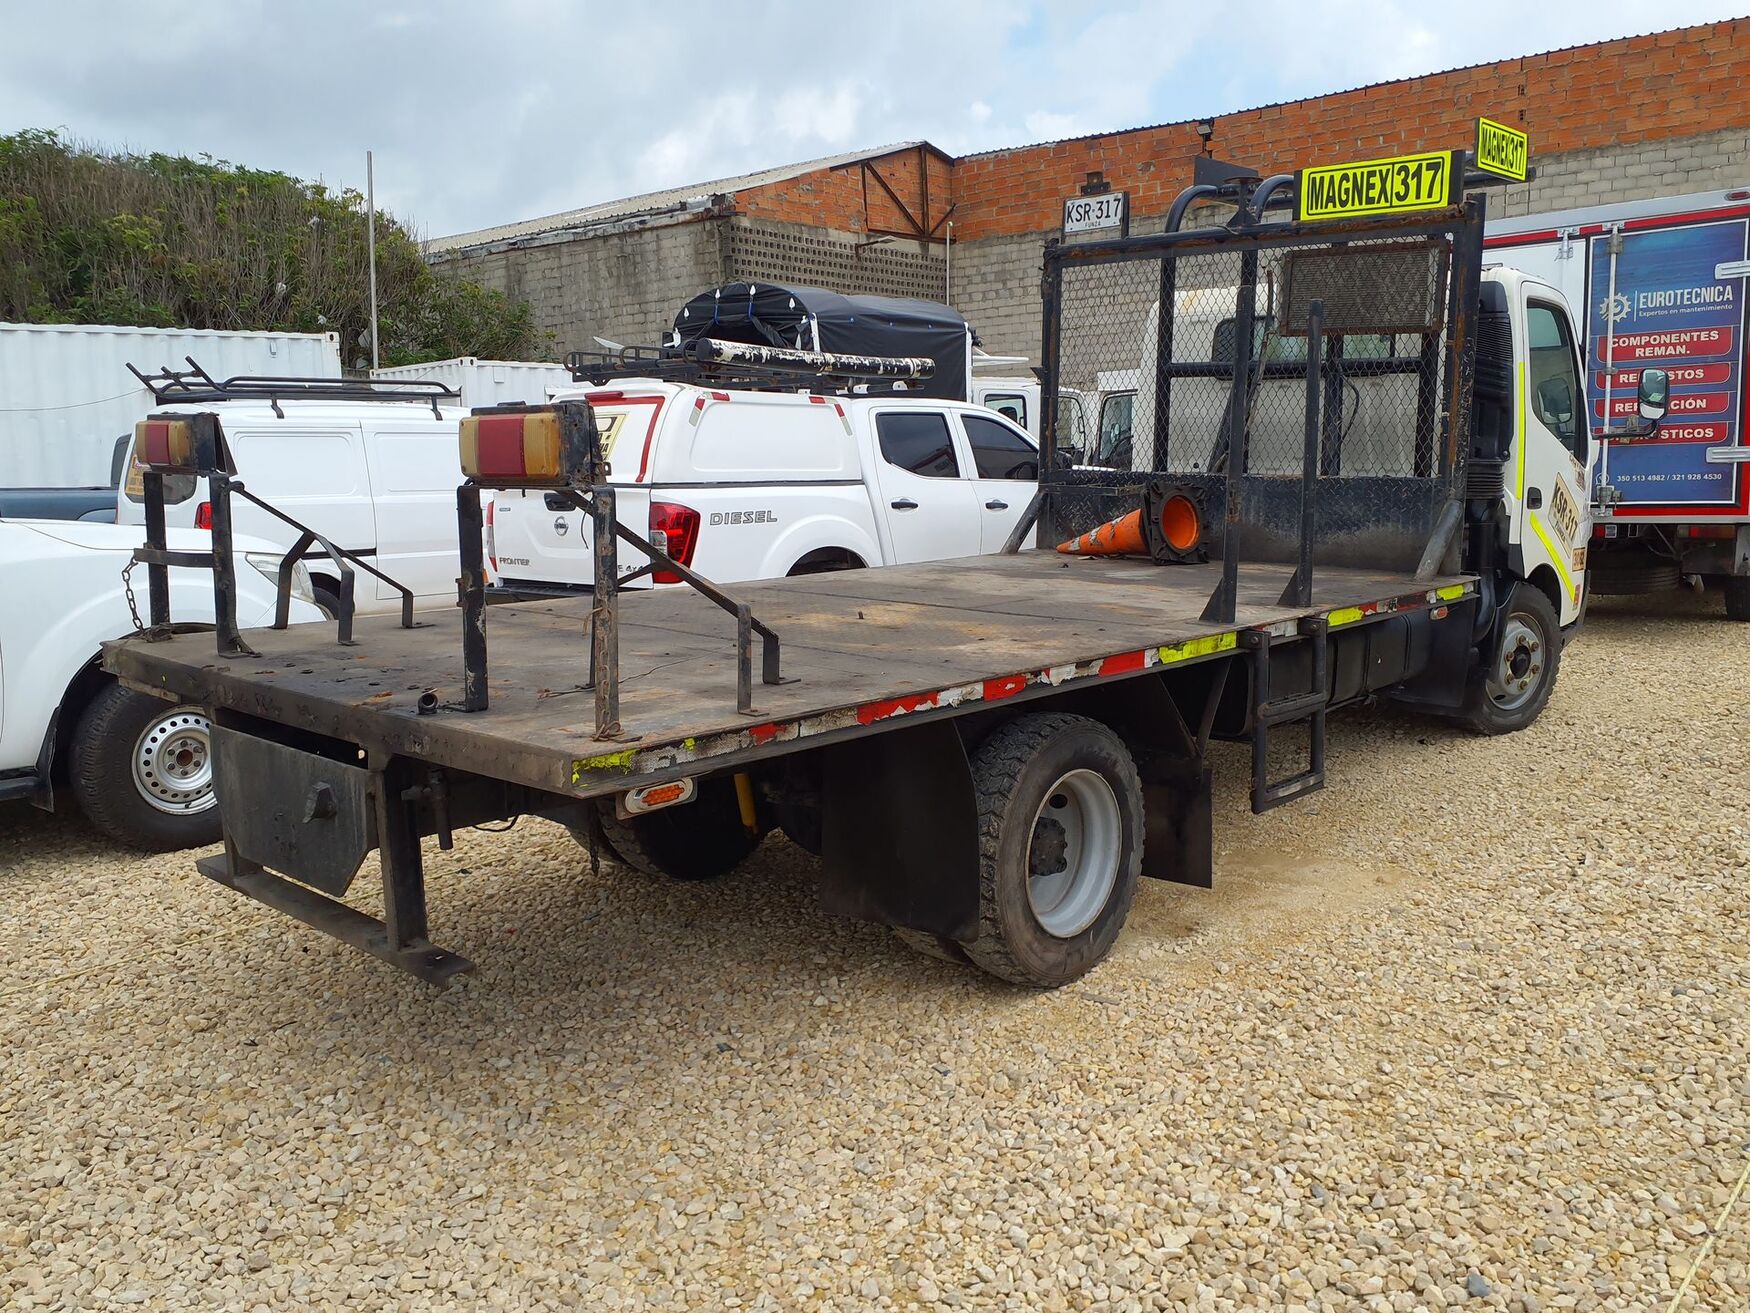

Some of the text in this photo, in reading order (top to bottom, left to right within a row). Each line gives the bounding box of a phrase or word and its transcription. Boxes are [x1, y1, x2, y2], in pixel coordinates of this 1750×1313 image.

[1310, 161, 1442, 211] MAGNEX 317
[1639, 285, 1733, 309] EUROTECNICA
[1639, 308, 1668, 317] Expertos
[1679, 303, 1733, 313] mantenimiento
[1611, 330, 1719, 348] COMPONENTES
[1635, 345, 1690, 357] REMAN.
[1620, 369, 1704, 383] RESTOS
[1615, 399, 1707, 413] RECIÓN
[709, 510, 778, 526] DIESEL
